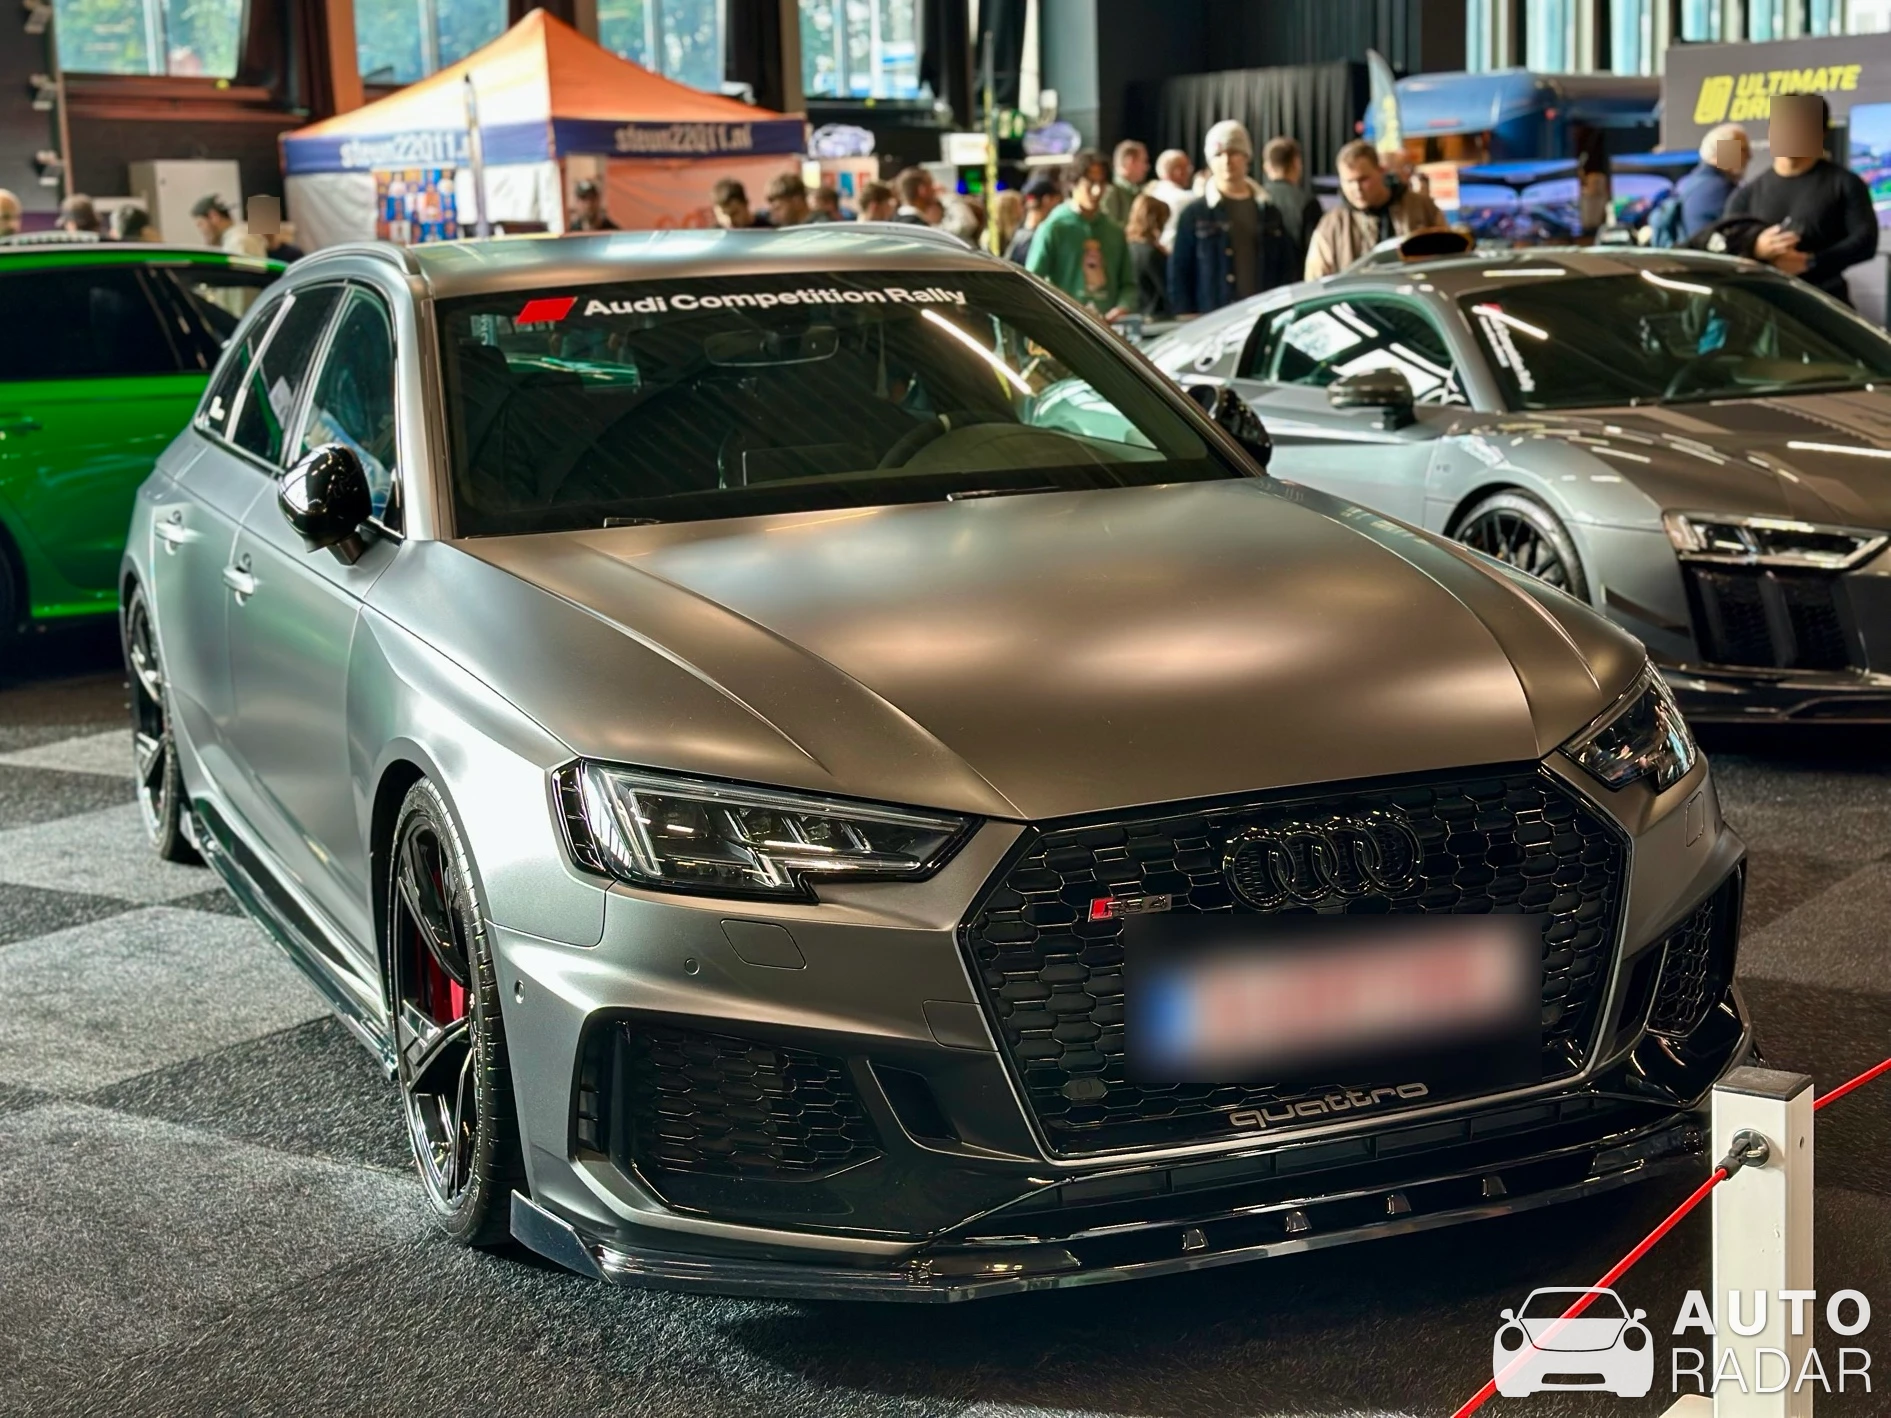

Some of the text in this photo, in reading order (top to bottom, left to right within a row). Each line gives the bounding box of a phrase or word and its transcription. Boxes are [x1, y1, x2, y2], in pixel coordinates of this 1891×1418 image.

[1735, 64, 1862, 97] ULTIMATE
[584, 287, 967, 317] Audi Competition Rally
[1229, 1082, 1430, 1128] quattro
